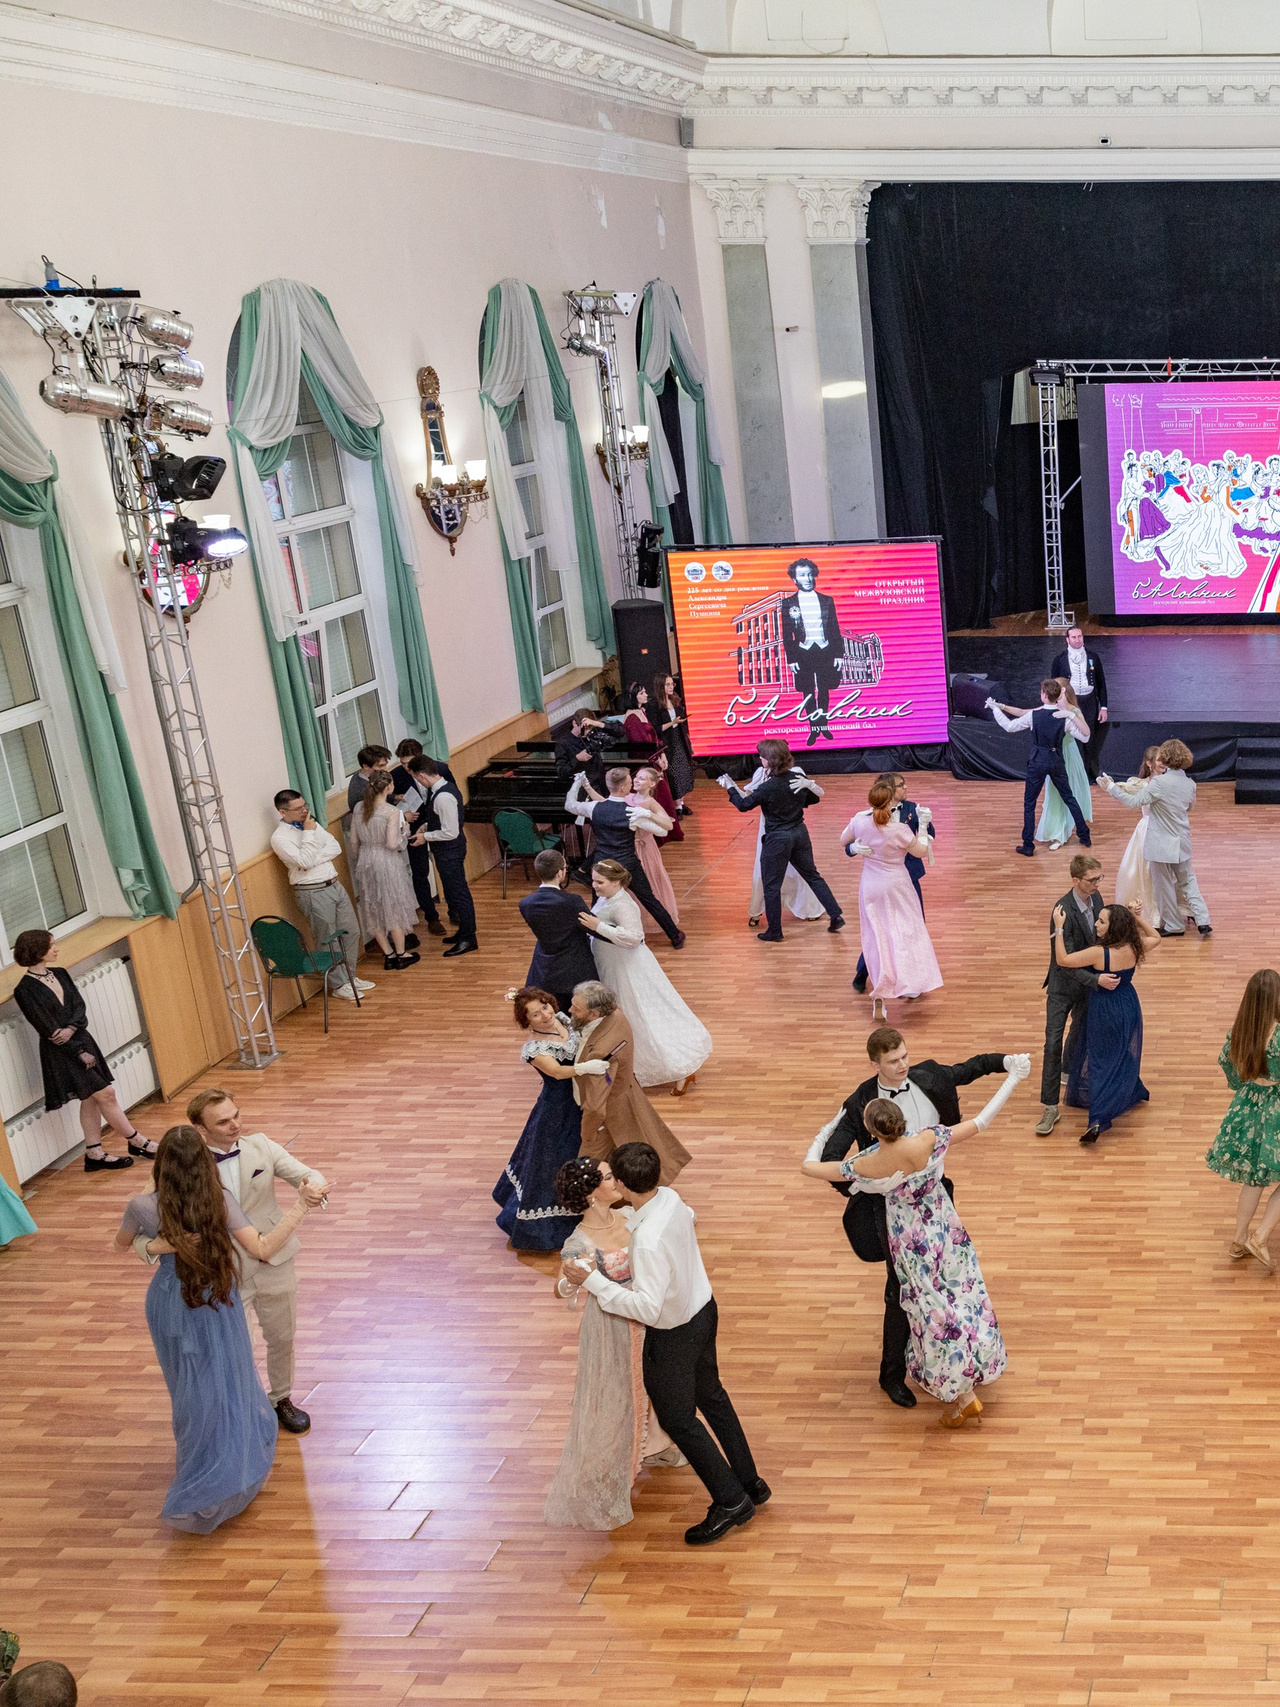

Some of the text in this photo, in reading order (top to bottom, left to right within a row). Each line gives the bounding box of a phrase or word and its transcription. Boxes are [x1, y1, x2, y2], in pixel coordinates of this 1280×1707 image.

[874, 577, 925, 587] ОТКРЫТЫЙ
[854, 587, 925, 597] МЕЖВУЗОВСКИЙ
[880, 596, 926, 605] ПРАЗДНИК
[763, 721, 877, 735] ректорский пушкинский бал
